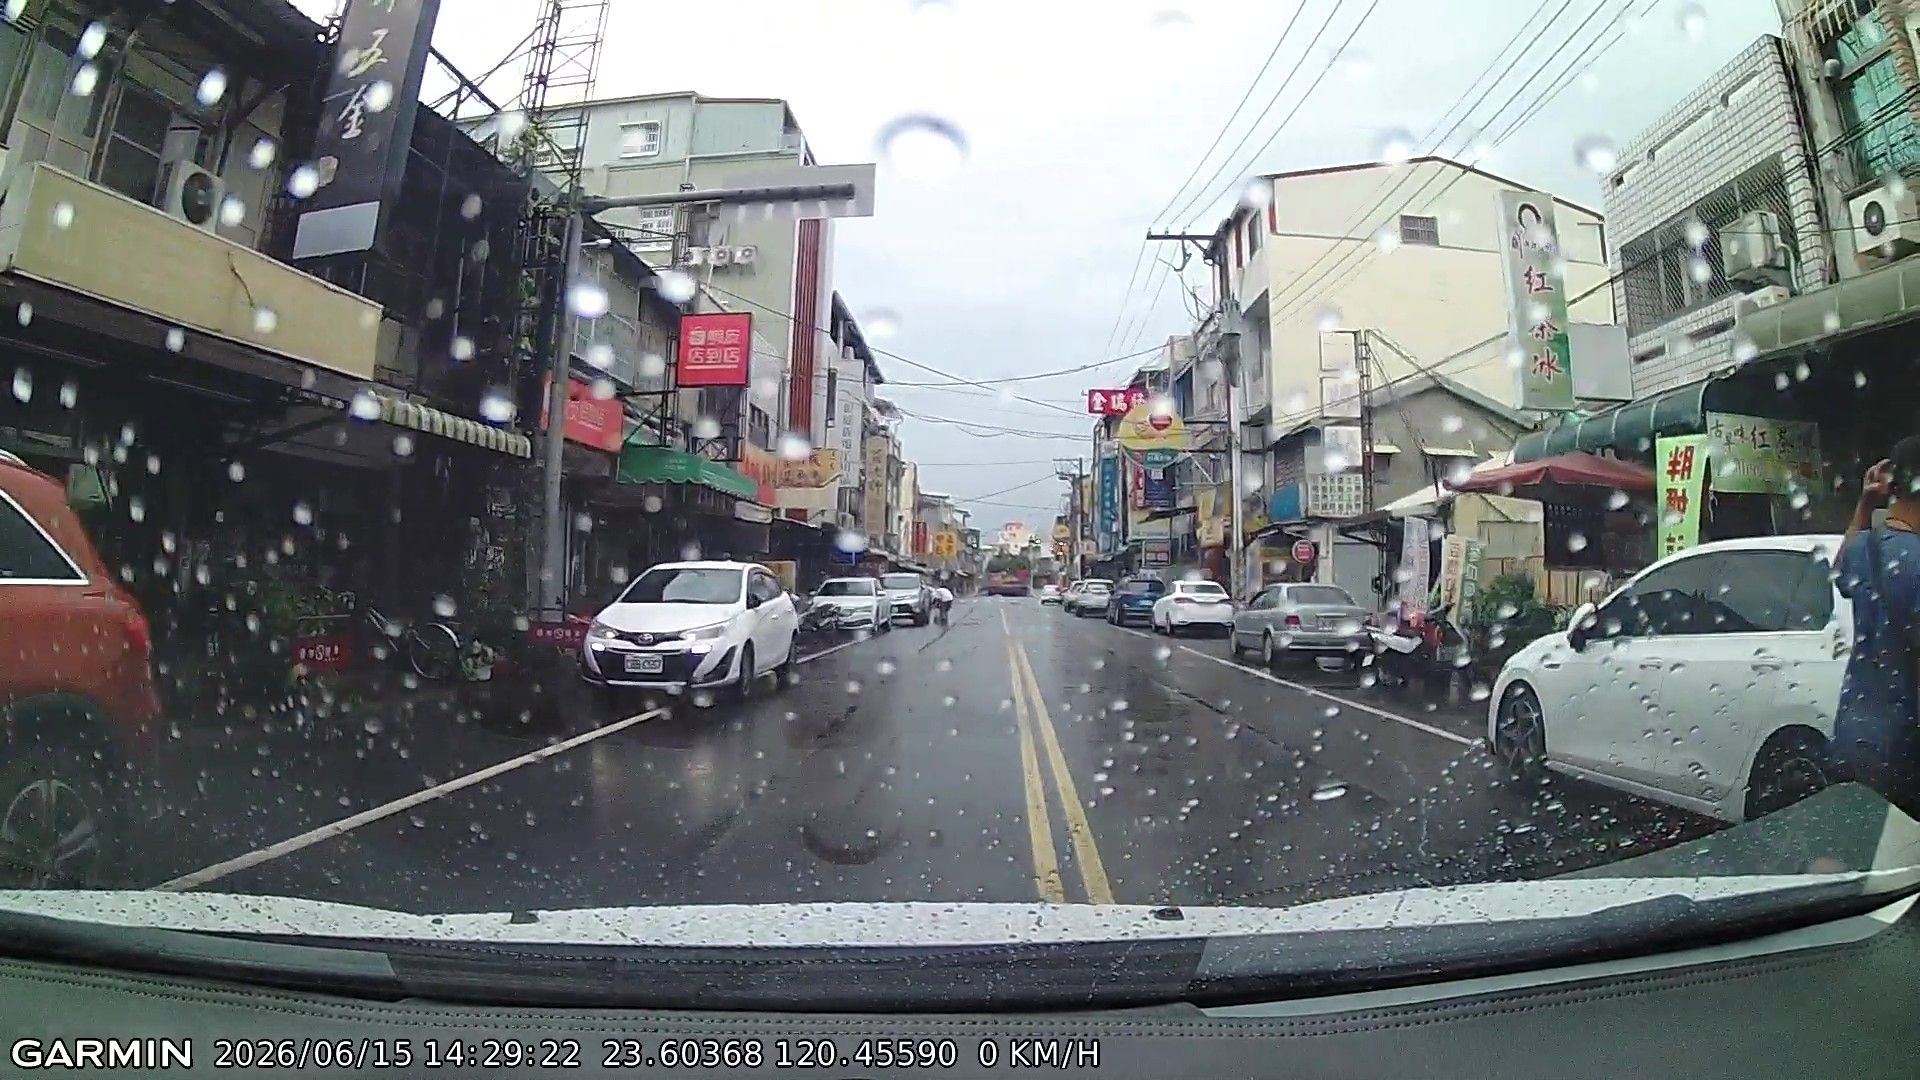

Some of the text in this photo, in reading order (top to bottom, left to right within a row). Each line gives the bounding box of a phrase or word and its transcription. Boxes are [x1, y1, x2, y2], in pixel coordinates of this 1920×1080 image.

[337, 0, 394, 139] 五金
[688, 347, 741, 364] 店到店
